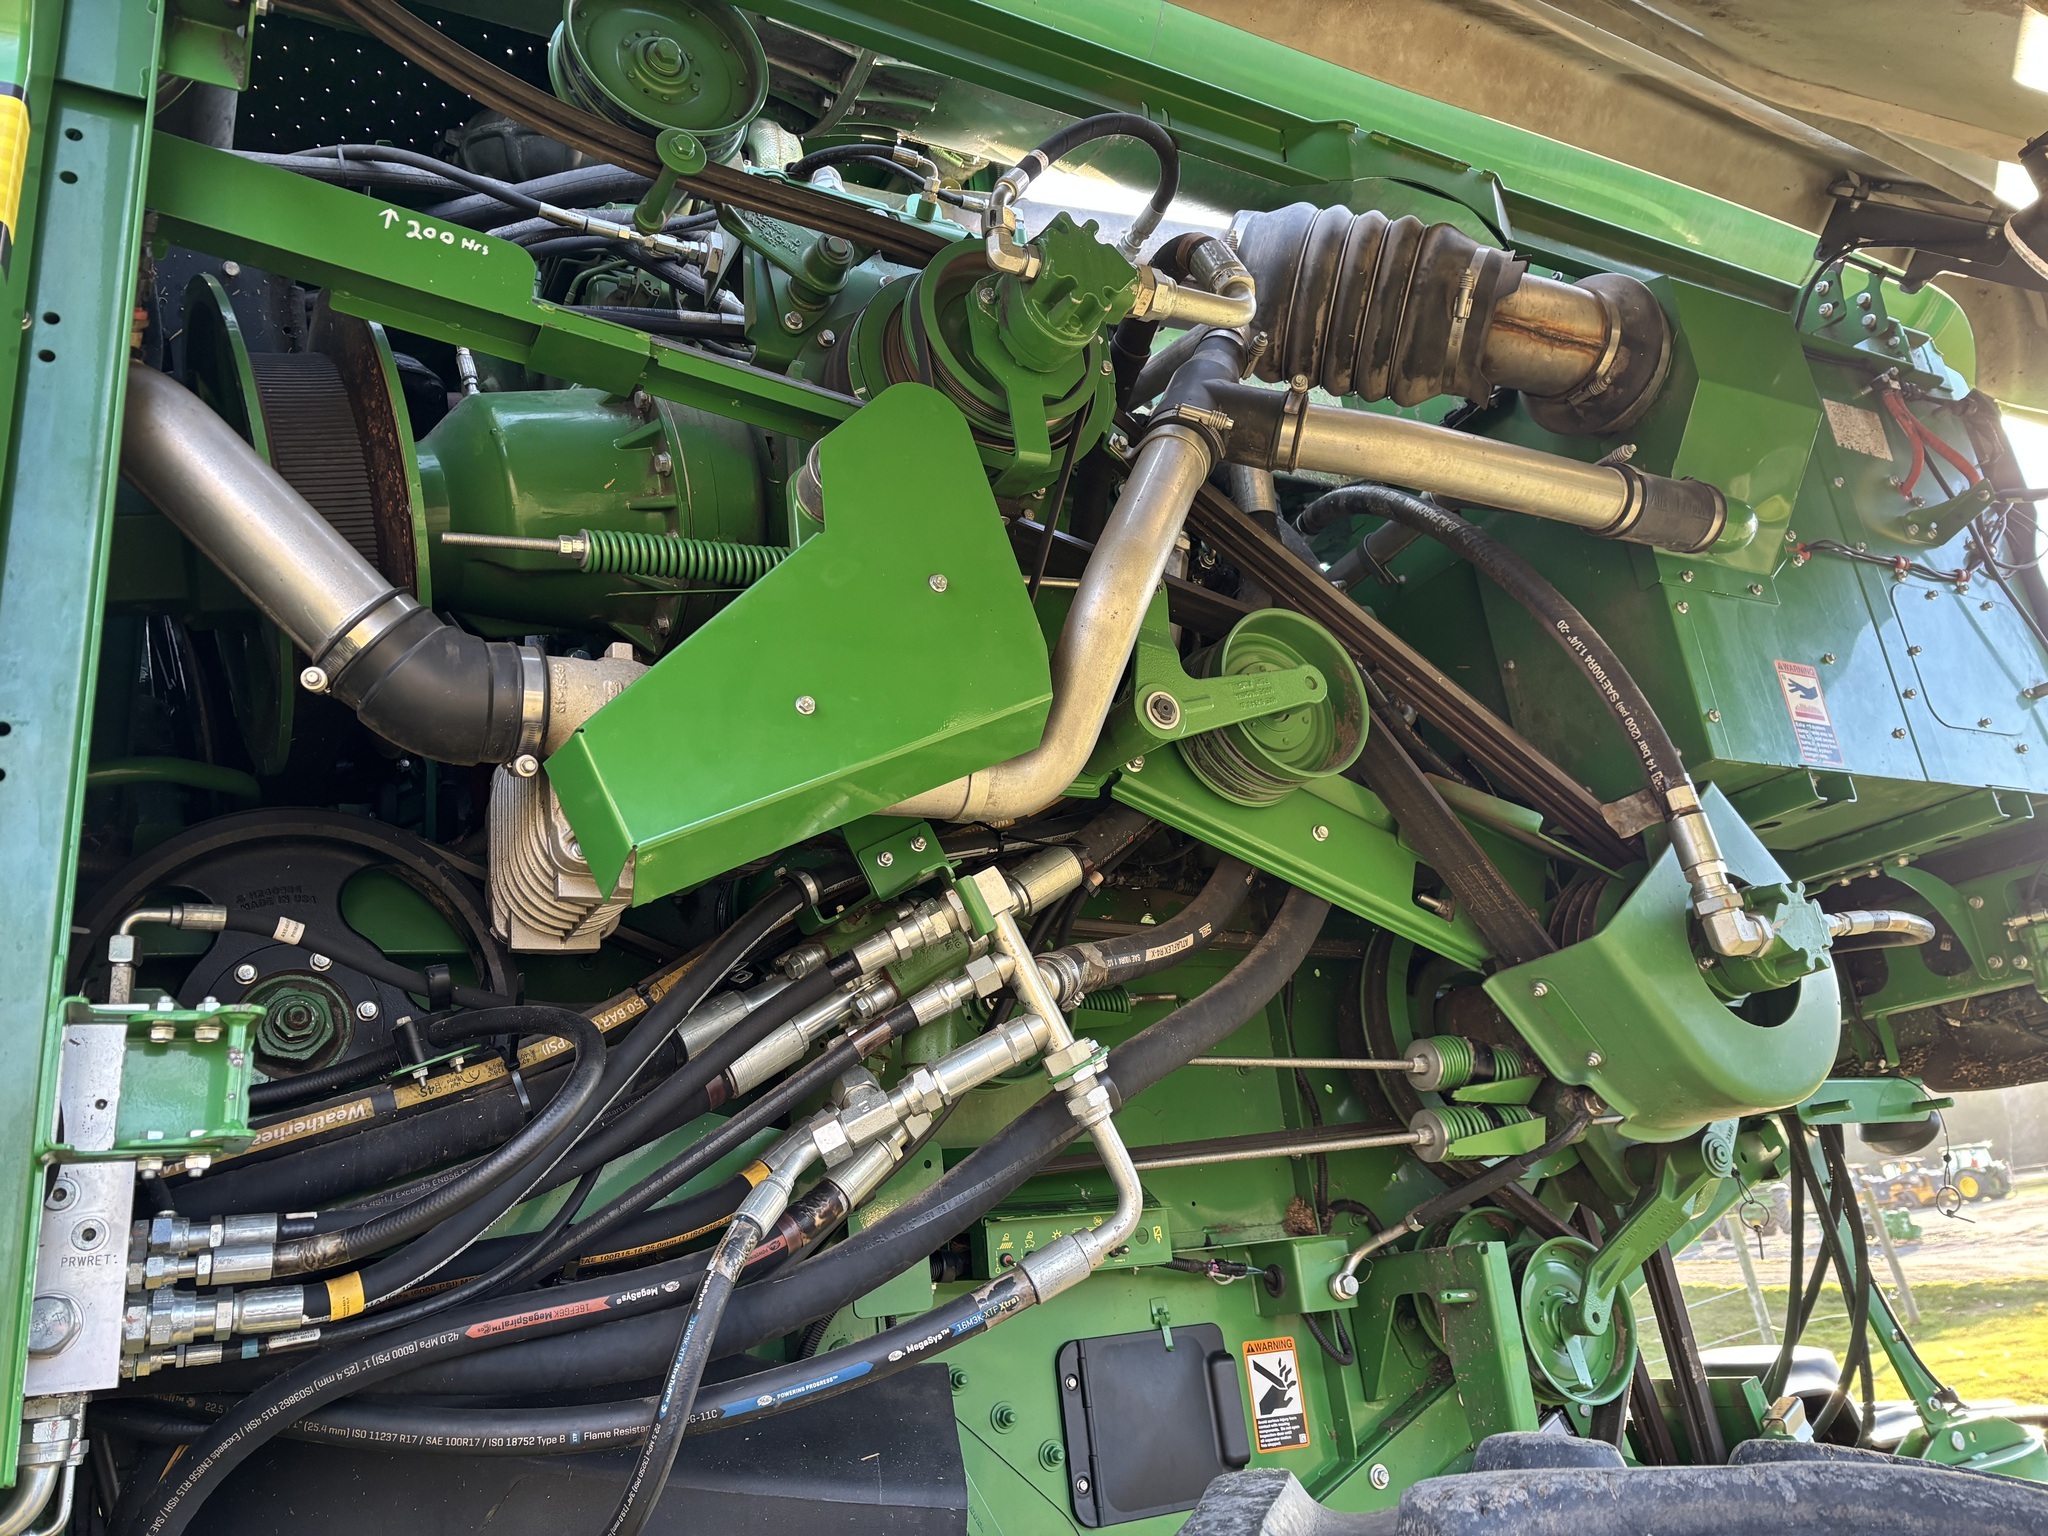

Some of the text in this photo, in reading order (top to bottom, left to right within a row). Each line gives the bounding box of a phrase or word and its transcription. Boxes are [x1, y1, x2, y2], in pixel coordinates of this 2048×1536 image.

[406, 220, 489, 256] 200 Hrs
[1584, 654, 1620, 703] SAE100R4
[1782, 663, 1815, 676] WARNING
[1615, 701, 1631, 718] psi)
[1624, 716, 1642, 741] (200
[1637, 739, 1652, 758] bar
[1645, 759, 1657, 772] 14
[600, 1007, 626, 1029] BAR
[542, 1037, 566, 1056] PSI)
[395, 1182, 431, 1200] Exceeds
[553, 1302, 590, 1319] 16EFG6K
[419, 1337, 438, 1350] MPa
[440, 1333, 460, 1345] 42.0
[906, 1328, 950, 1354] MegaSys™
[1254, 1338, 1293, 1352] WARNING
[371, 1352, 391, 1367] PSI)
[392, 1342, 418, 1359] (6000
[336, 1361, 360, 1382] (25.4
[315, 1374, 336, 1391] mm)
[279, 1385, 315, 1411] ISO3862
[776, 1386, 806, 1400] POWERING
[205, 1402, 223, 1414] 22.5
[261, 1405, 280, 1422] R15
[245, 1417, 262, 1434] 4SH
[303, 1420, 328, 1434] (25.4
[328, 1427, 350, 1440] mm)
[351, 1428, 367, 1439] ISO
[369, 1431, 398, 1443] 11237
[400, 1433, 418, 1445] R17
[425, 1436, 443, 1446] SAE
[445, 1436, 481, 1447] 100R17
[488, 1437, 503, 1447] ISO
[506, 1436, 535, 1447] 18752
[537, 1435, 558, 1446] Type
[559, 1434, 566, 1444] B
[584, 1431, 611, 1441] Flame
[613, 1424, 651, 1437] Resistan
[211, 1432, 242, 1460] Exceeds
[188, 1457, 214, 1483] EN856
[175, 1480, 193, 1498] R15
[164, 1495, 181, 1514] 4SH
[149, 1516, 166, 1534] SAE
